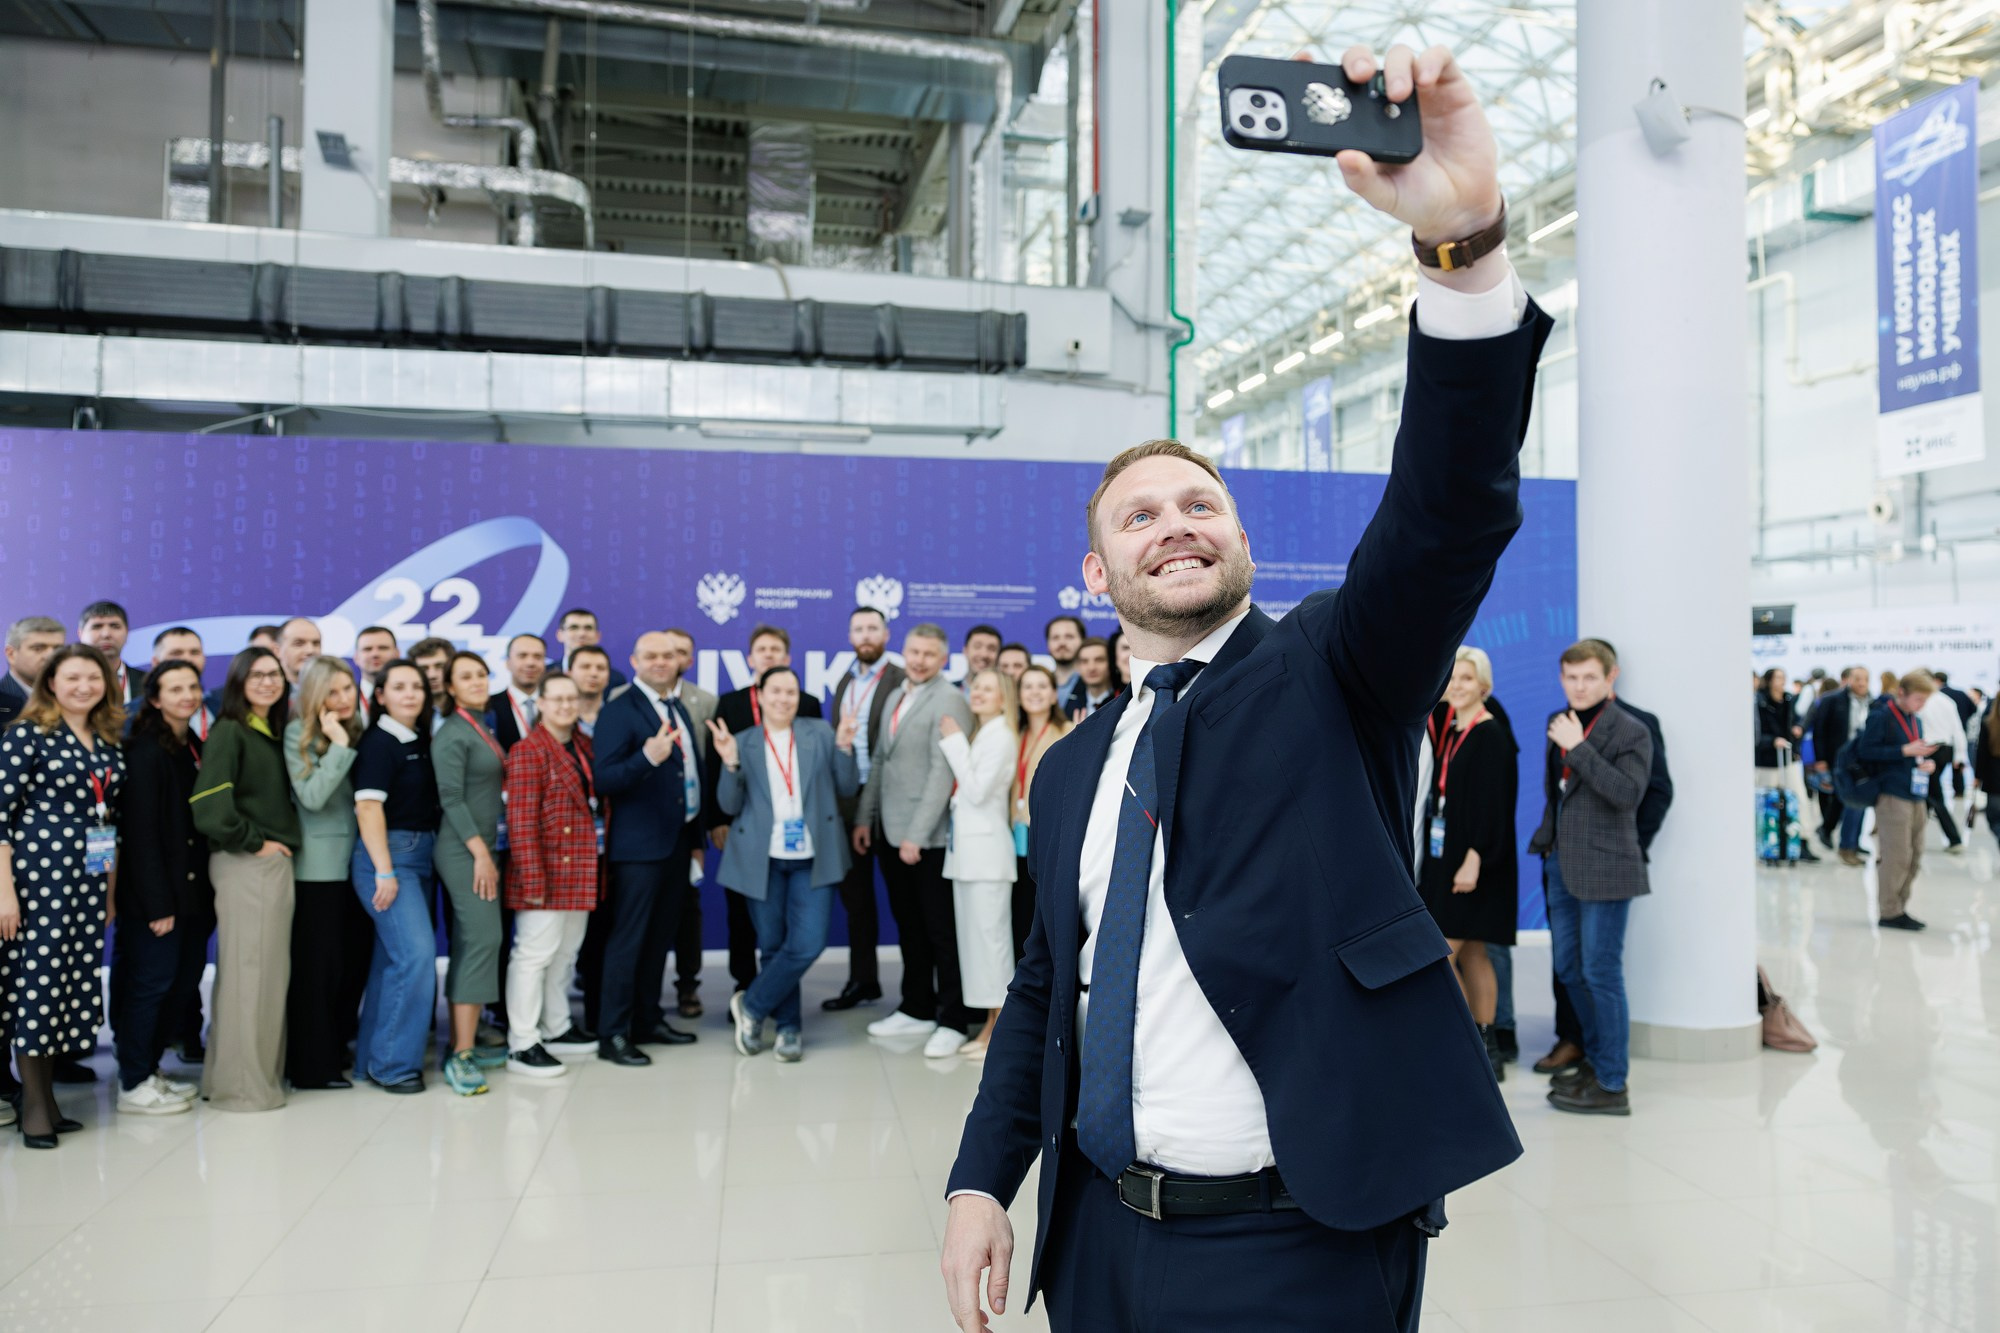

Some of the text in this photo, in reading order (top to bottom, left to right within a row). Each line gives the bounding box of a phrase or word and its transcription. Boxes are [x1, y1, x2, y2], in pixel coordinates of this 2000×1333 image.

[1892, 191, 1914, 334] КОНГРЕСС
[1916, 207, 1939, 360] МОЛОДЫХ
[1939, 228, 1962, 355] УЧЕНЫХ
[1896, 360, 1963, 392] наука.рф
